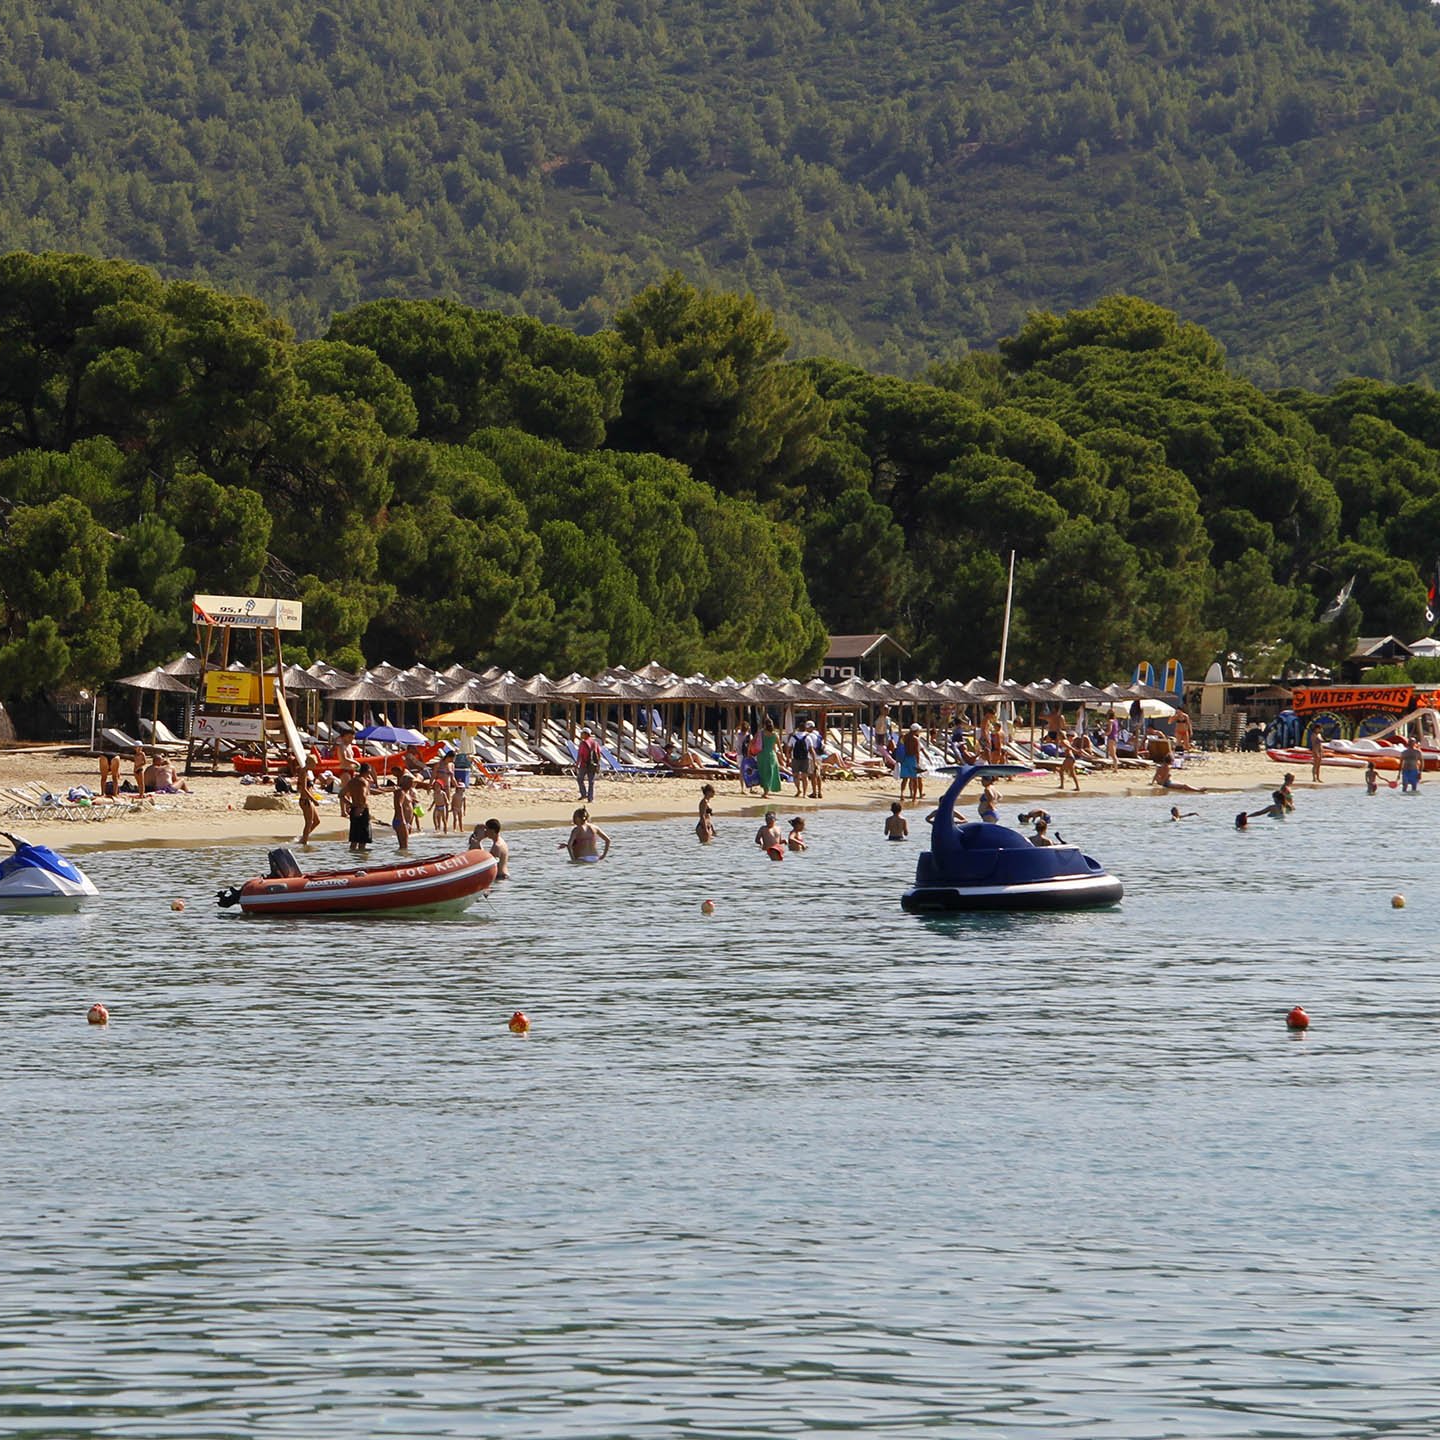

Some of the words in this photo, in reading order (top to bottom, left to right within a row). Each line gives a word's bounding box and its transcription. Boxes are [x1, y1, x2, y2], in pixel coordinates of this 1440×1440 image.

[1310, 691, 1353, 704] WATER
[1356, 689, 1408, 702] SPORTS
[396, 866, 428, 878] FOR
[434, 855, 469, 872] RENT
[304, 878, 349, 888] MOSTRO
